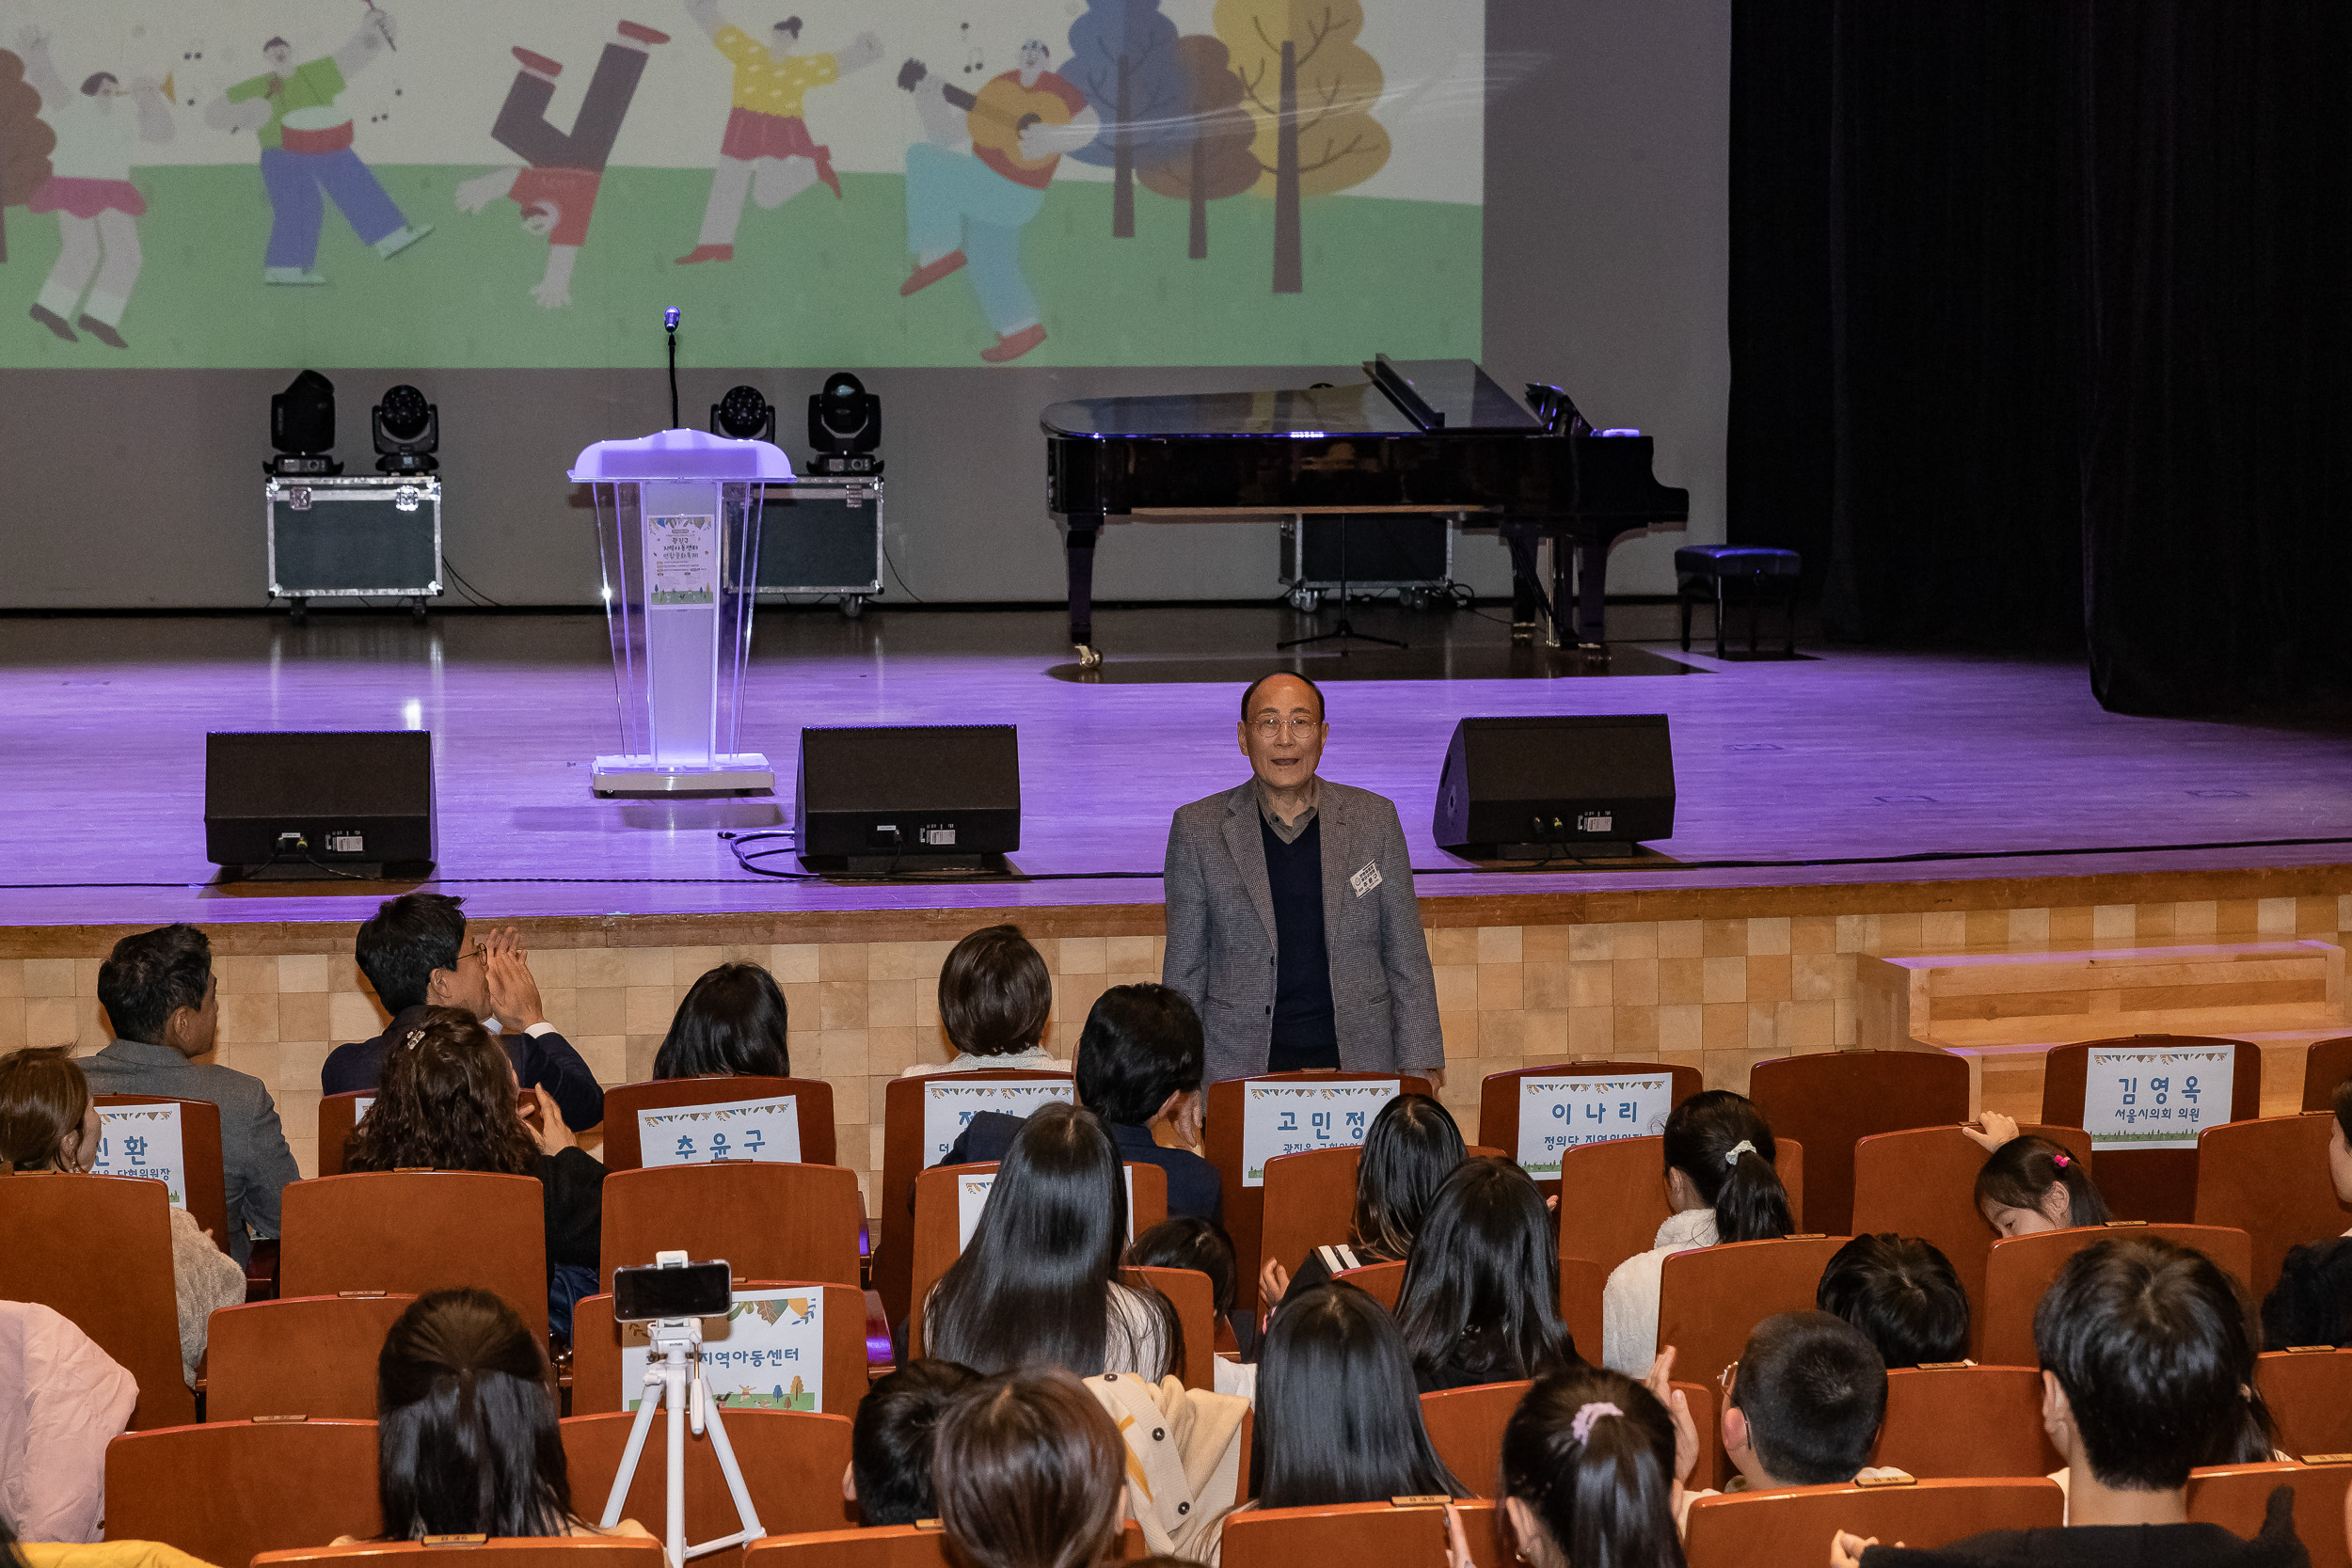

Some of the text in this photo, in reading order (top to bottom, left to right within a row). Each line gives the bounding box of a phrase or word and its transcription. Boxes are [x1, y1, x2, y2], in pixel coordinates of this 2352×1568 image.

[2114, 1107, 2201, 1124] 서울시의회 의원
[1544, 1134, 1580, 1151] 정의당
